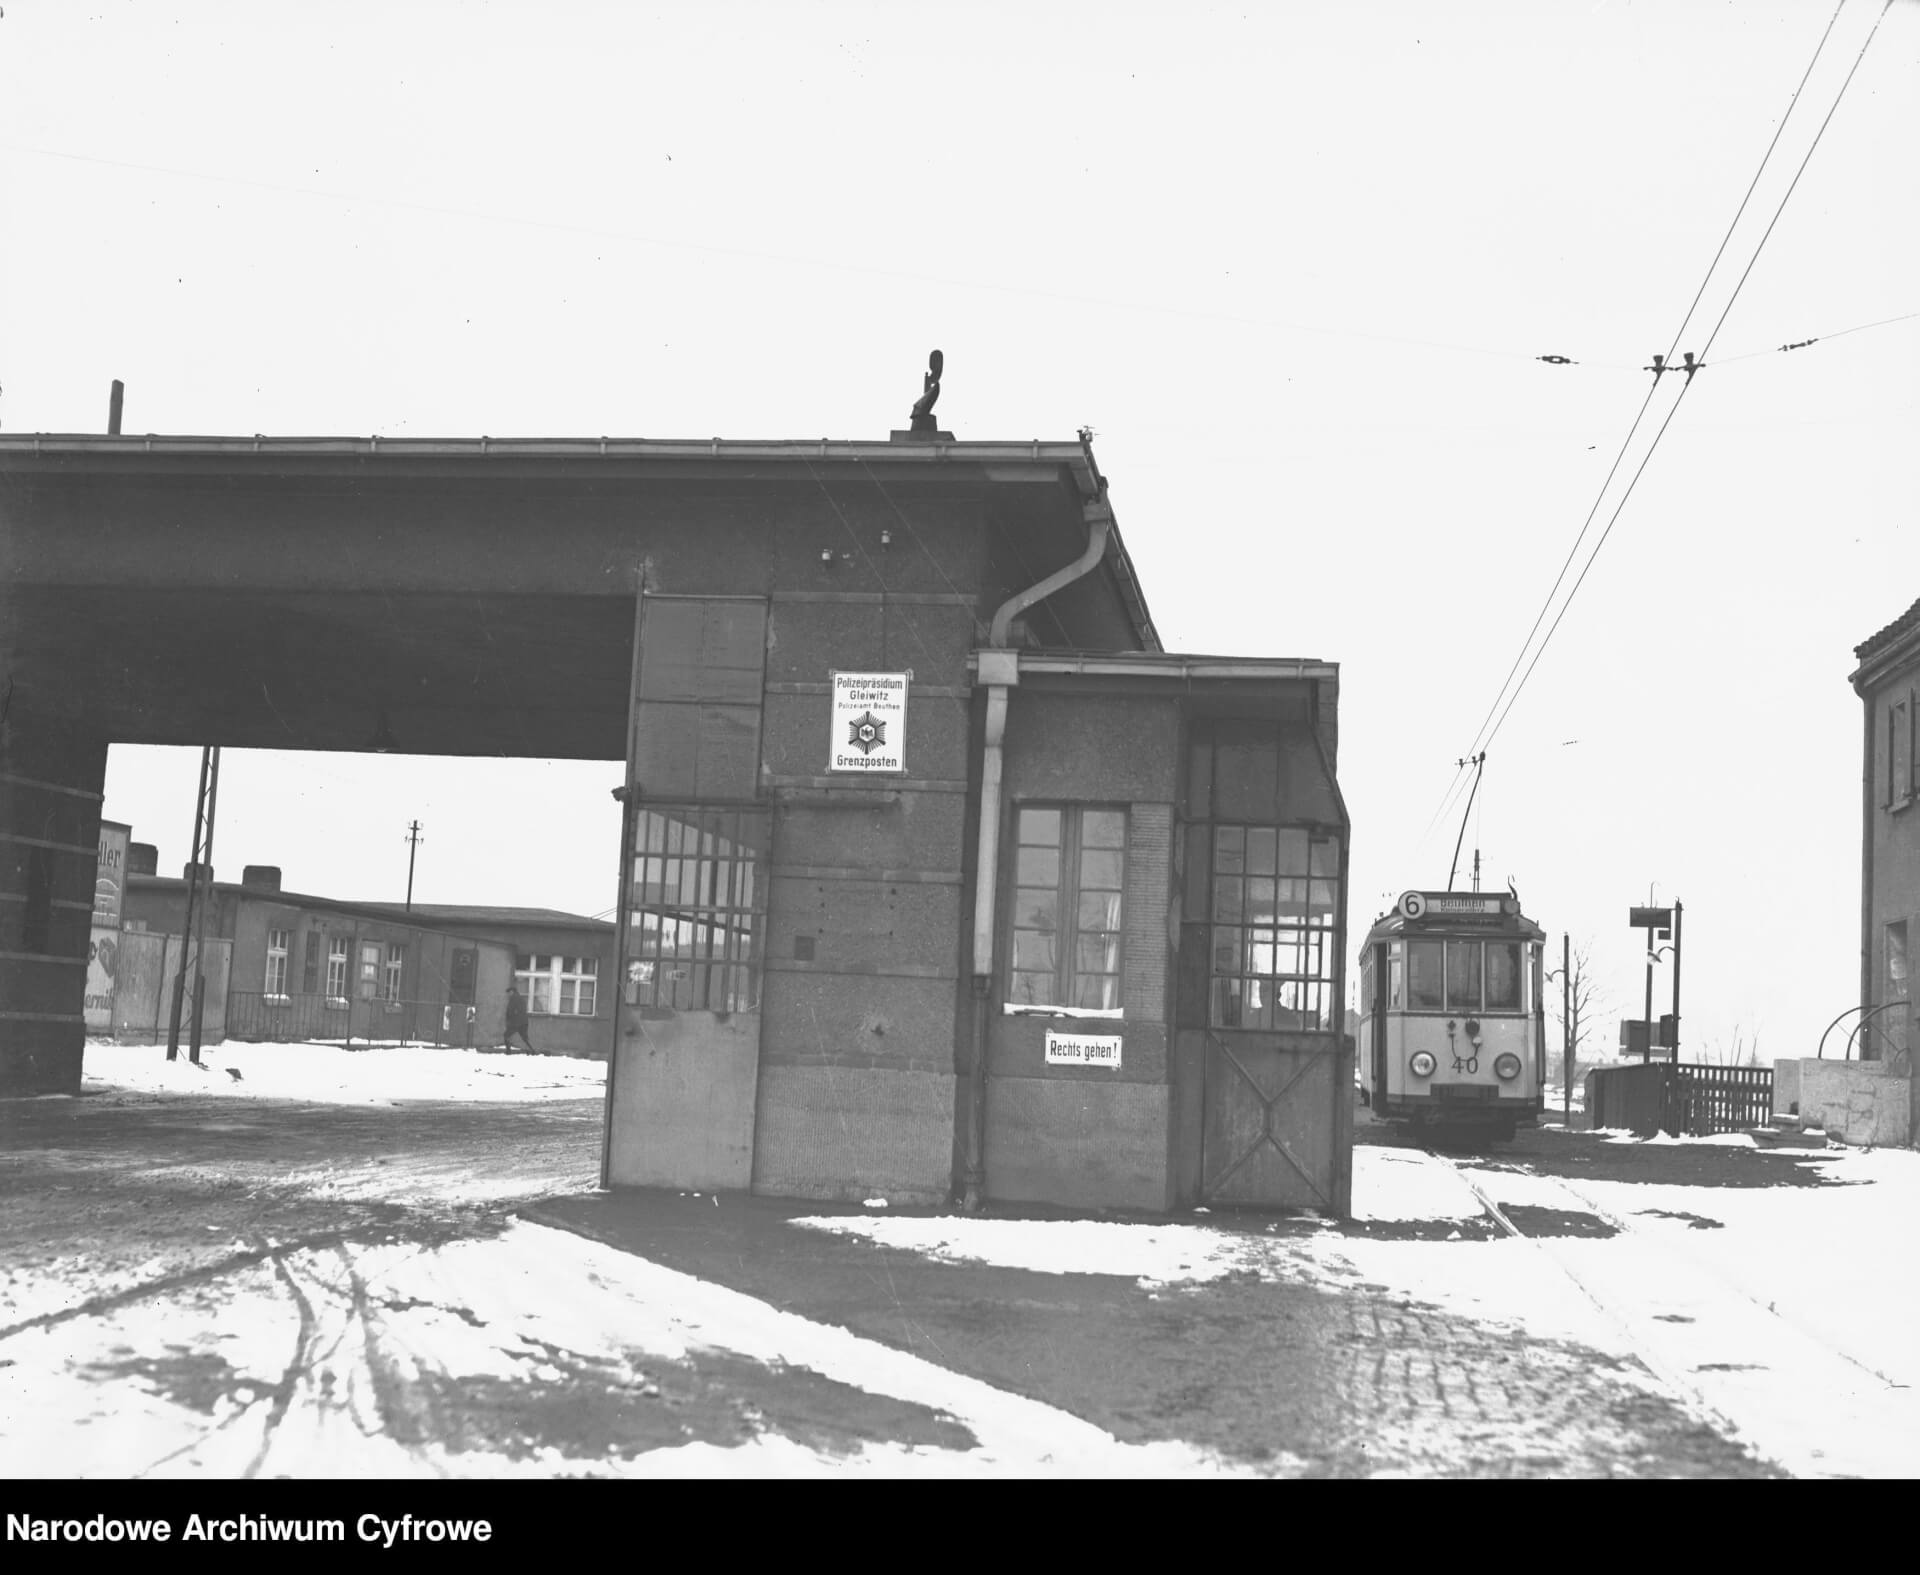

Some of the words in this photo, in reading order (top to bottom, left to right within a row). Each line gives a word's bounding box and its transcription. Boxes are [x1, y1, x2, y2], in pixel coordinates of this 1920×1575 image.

[837, 677, 903, 690] Polizeipräsidium
[849, 690, 889, 701] Gleiwitz
[837, 754, 897, 768] Grenzposten
[1405, 894, 1420, 916] 6
[1050, 1040, 1081, 1057] Rechts
[1451, 1056, 1478, 1074] 40
